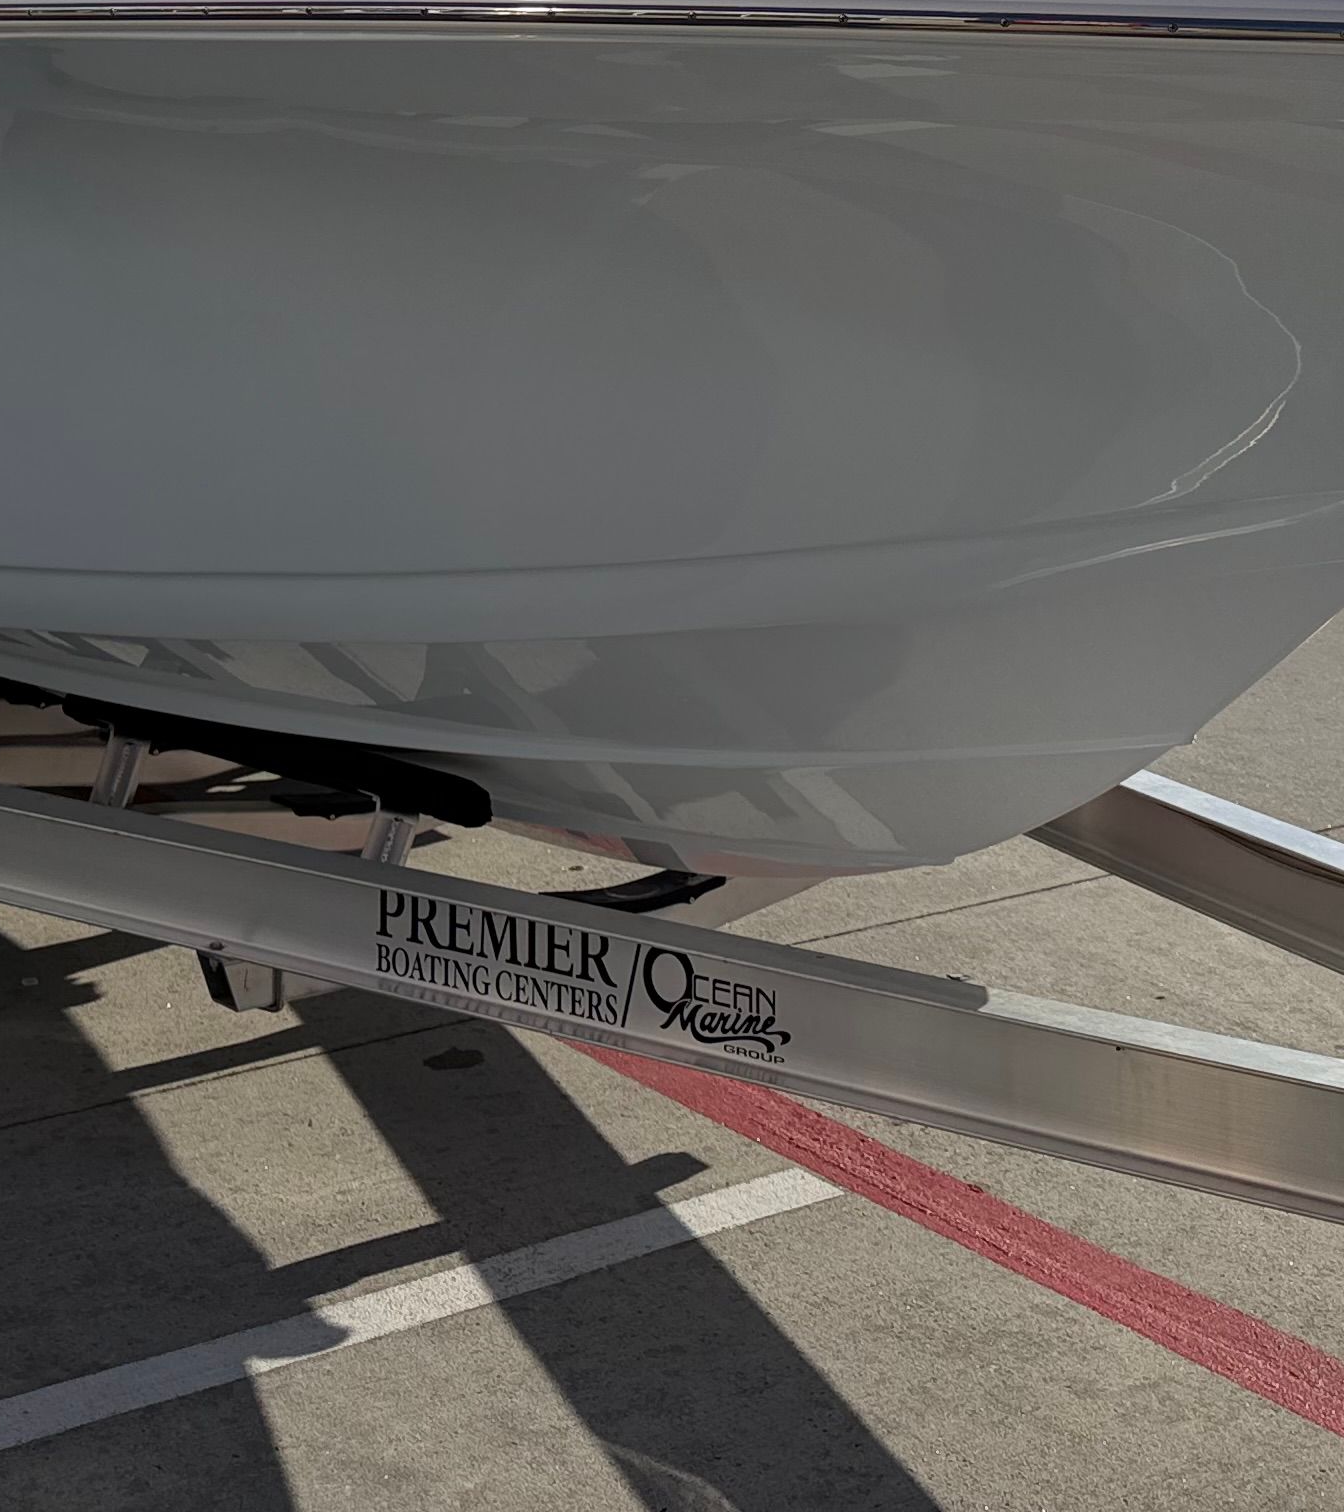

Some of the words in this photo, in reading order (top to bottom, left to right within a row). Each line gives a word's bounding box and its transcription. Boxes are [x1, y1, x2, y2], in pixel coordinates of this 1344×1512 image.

[376, 888, 618, 988] PREMIER
[376, 943, 490, 997] BOATING
[495, 970, 618, 1026] CENTERS
[660, 999, 792, 1053] Marine
[723, 1044, 785, 1064] GROUP
